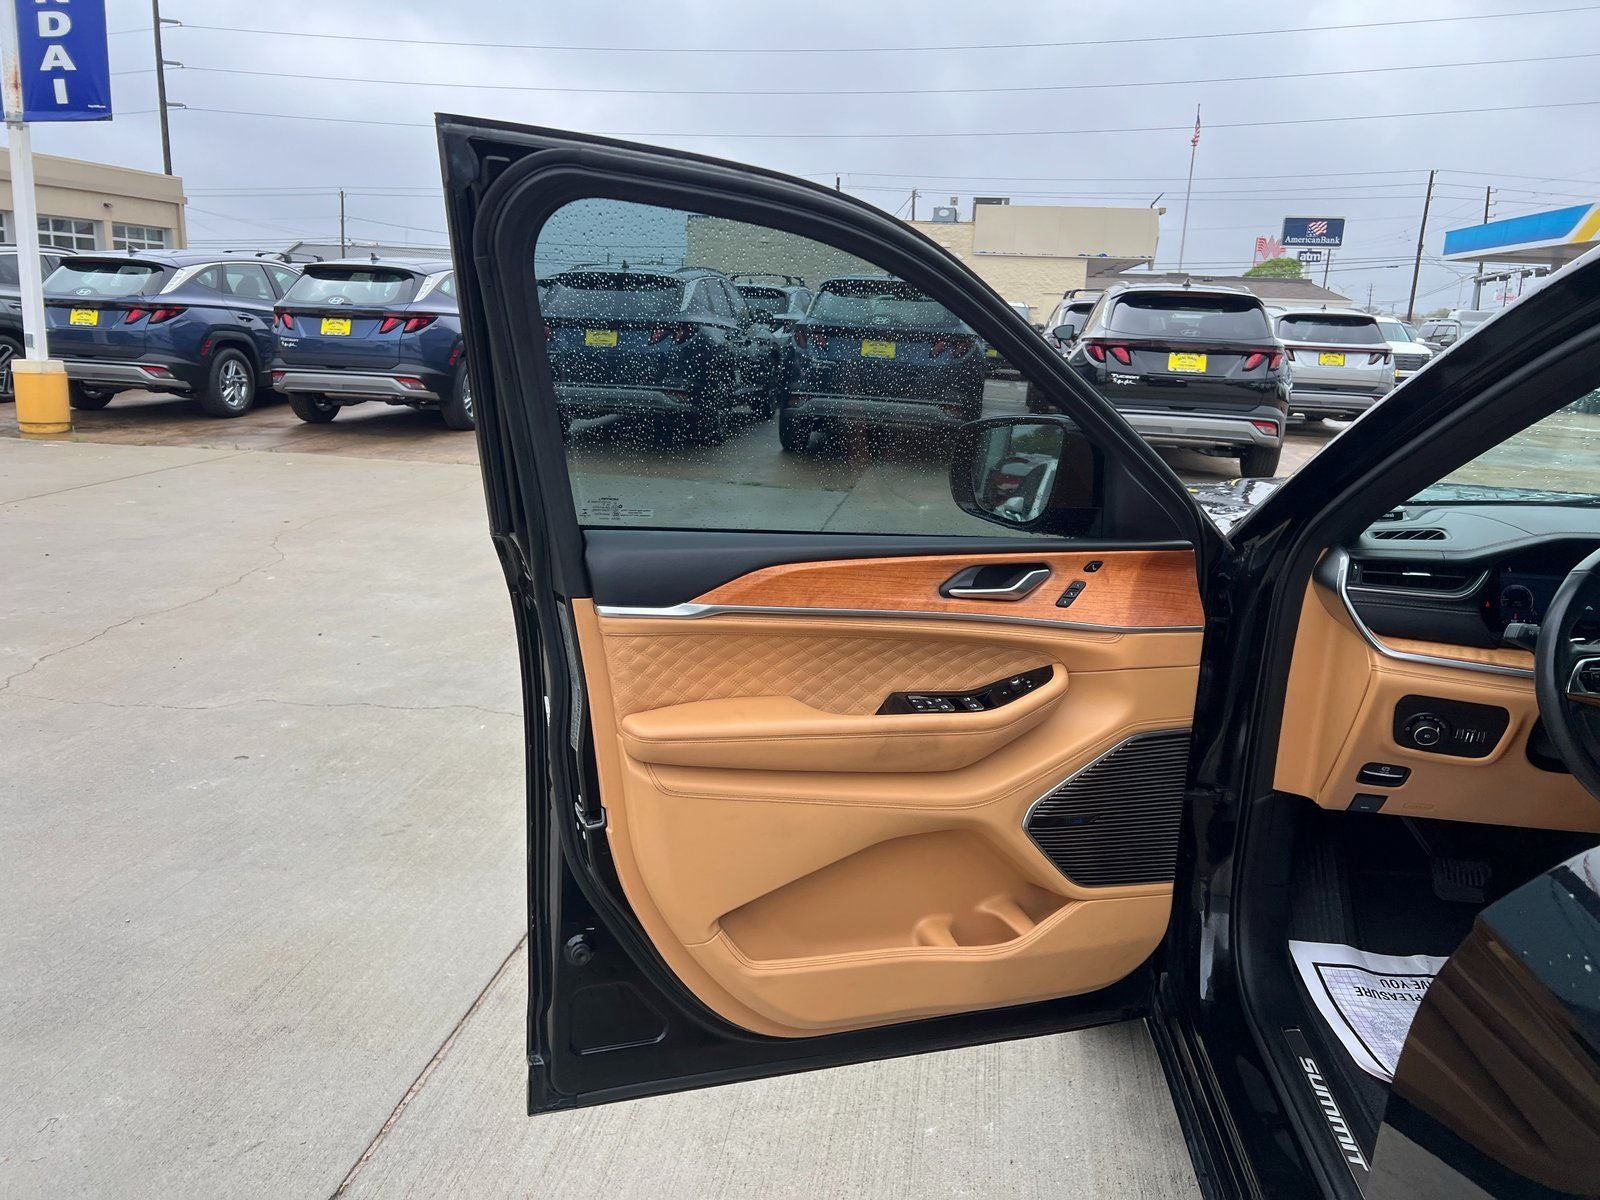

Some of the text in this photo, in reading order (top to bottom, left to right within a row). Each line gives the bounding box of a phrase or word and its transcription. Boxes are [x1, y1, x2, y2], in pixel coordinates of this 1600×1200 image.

[35, 0, 77, 104] DAI
[1285, 236, 1340, 244] AmericanBank
[1300, 252, 1320, 261] atm
[1379, 979, 1410, 989] YOU
[1353, 986, 1423, 1002] PLEASURE
[1299, 1056, 1369, 1172] SUMMIT
